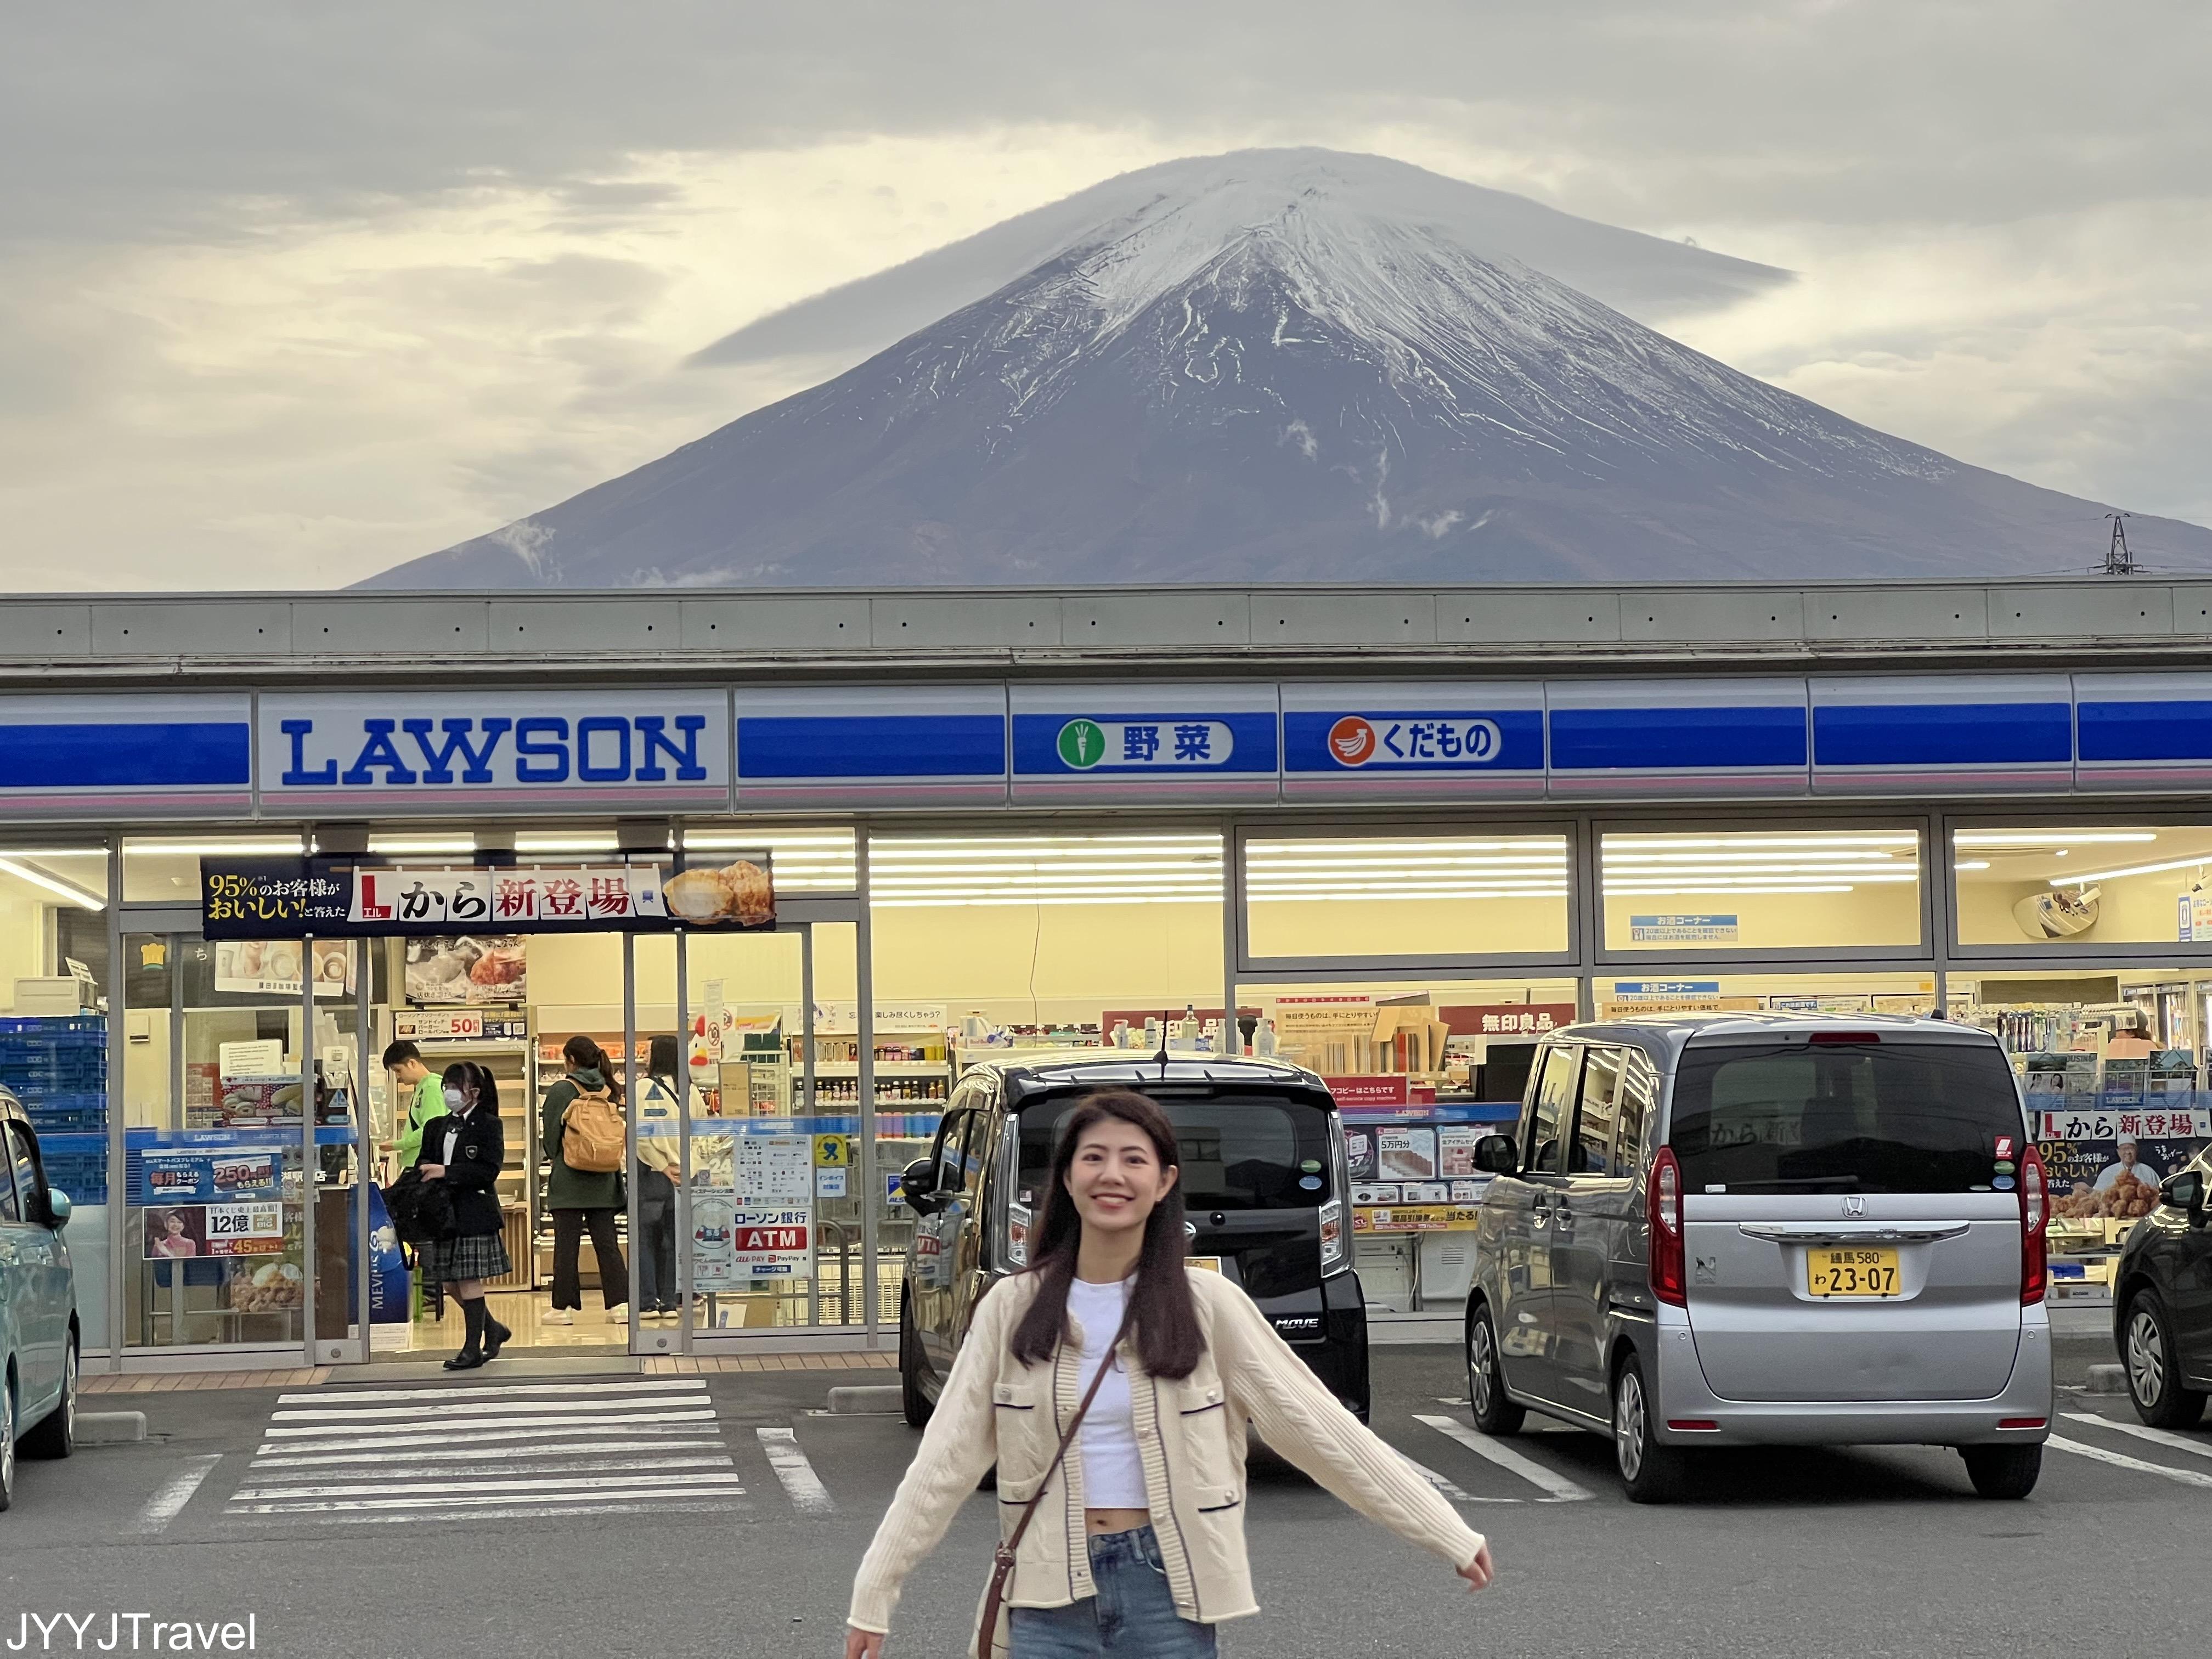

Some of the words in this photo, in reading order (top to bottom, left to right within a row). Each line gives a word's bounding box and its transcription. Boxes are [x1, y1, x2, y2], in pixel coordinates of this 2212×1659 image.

[1122, 723, 1212, 763] 野菜
[1383, 721, 1492, 759] くだもの
[281, 715, 707, 786] LAWSON
[1657, 916, 1711, 926] お酒コーナー
[1641, 983, 1693, 992] お酒コーナー
[1482, 1013, 1554, 1032] 無印良品
[1381, 1140, 1410, 1149] 5万円分
[709, 1158, 732, 1174] 24
[211, 1215, 249, 1233] 12億
[735, 1211, 806, 1224] ローソン銀行
[747, 1230, 796, 1248] ATM
[1857, 1252, 1880, 1264] 580
[1814, 1274, 1826, 1285] わ
[1829, 1268, 1895, 1291] 23-07
